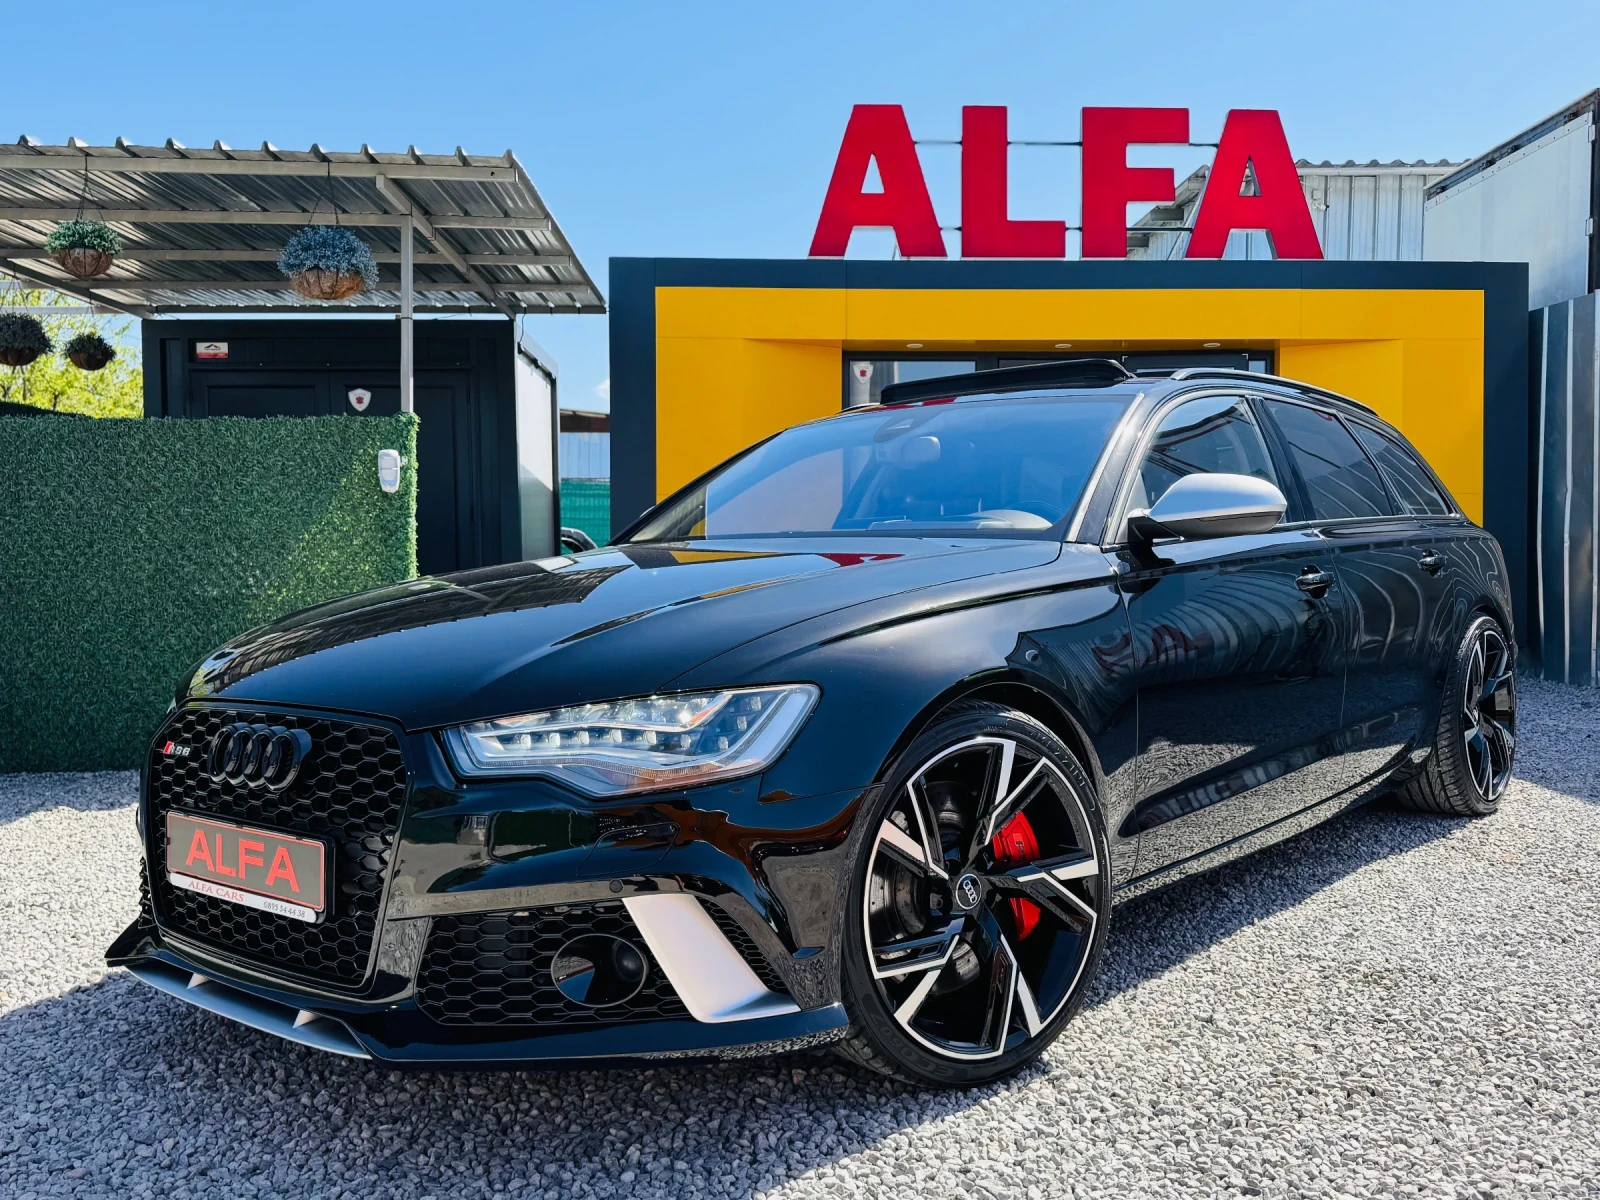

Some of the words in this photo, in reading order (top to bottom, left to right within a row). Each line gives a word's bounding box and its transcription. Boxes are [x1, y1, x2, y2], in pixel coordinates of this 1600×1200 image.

[807, 103, 1325, 260] ALFA
[163, 740, 191, 756] RS6
[185, 829, 300, 893] ALFA
[188, 879, 214, 894] ALFA
[215, 886, 245, 903] CARS
